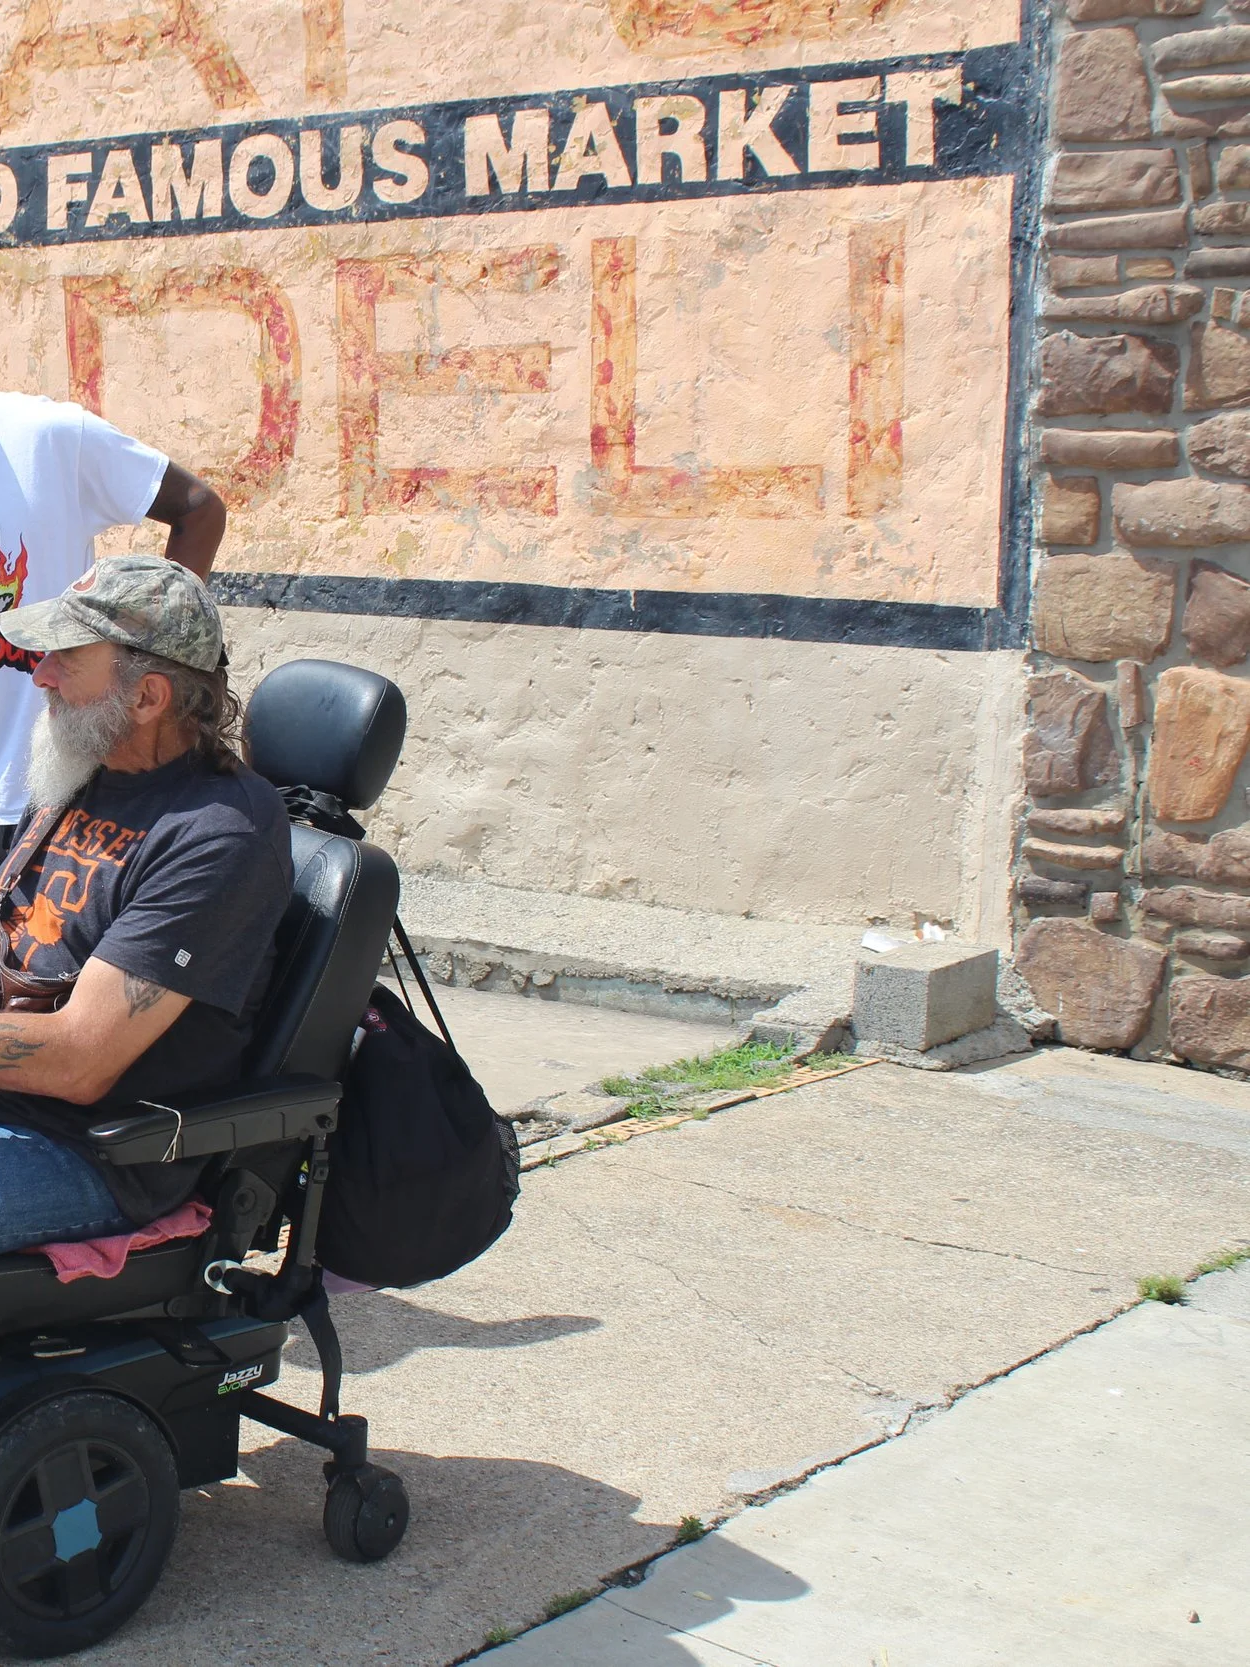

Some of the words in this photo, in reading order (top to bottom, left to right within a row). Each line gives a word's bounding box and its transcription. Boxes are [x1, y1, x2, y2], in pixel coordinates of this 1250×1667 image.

[47, 119, 430, 232] FAMOUS
[463, 64, 963, 196] MARKET
[65, 221, 906, 518] DELI
[218, 1364, 263, 1386] Jazzy
